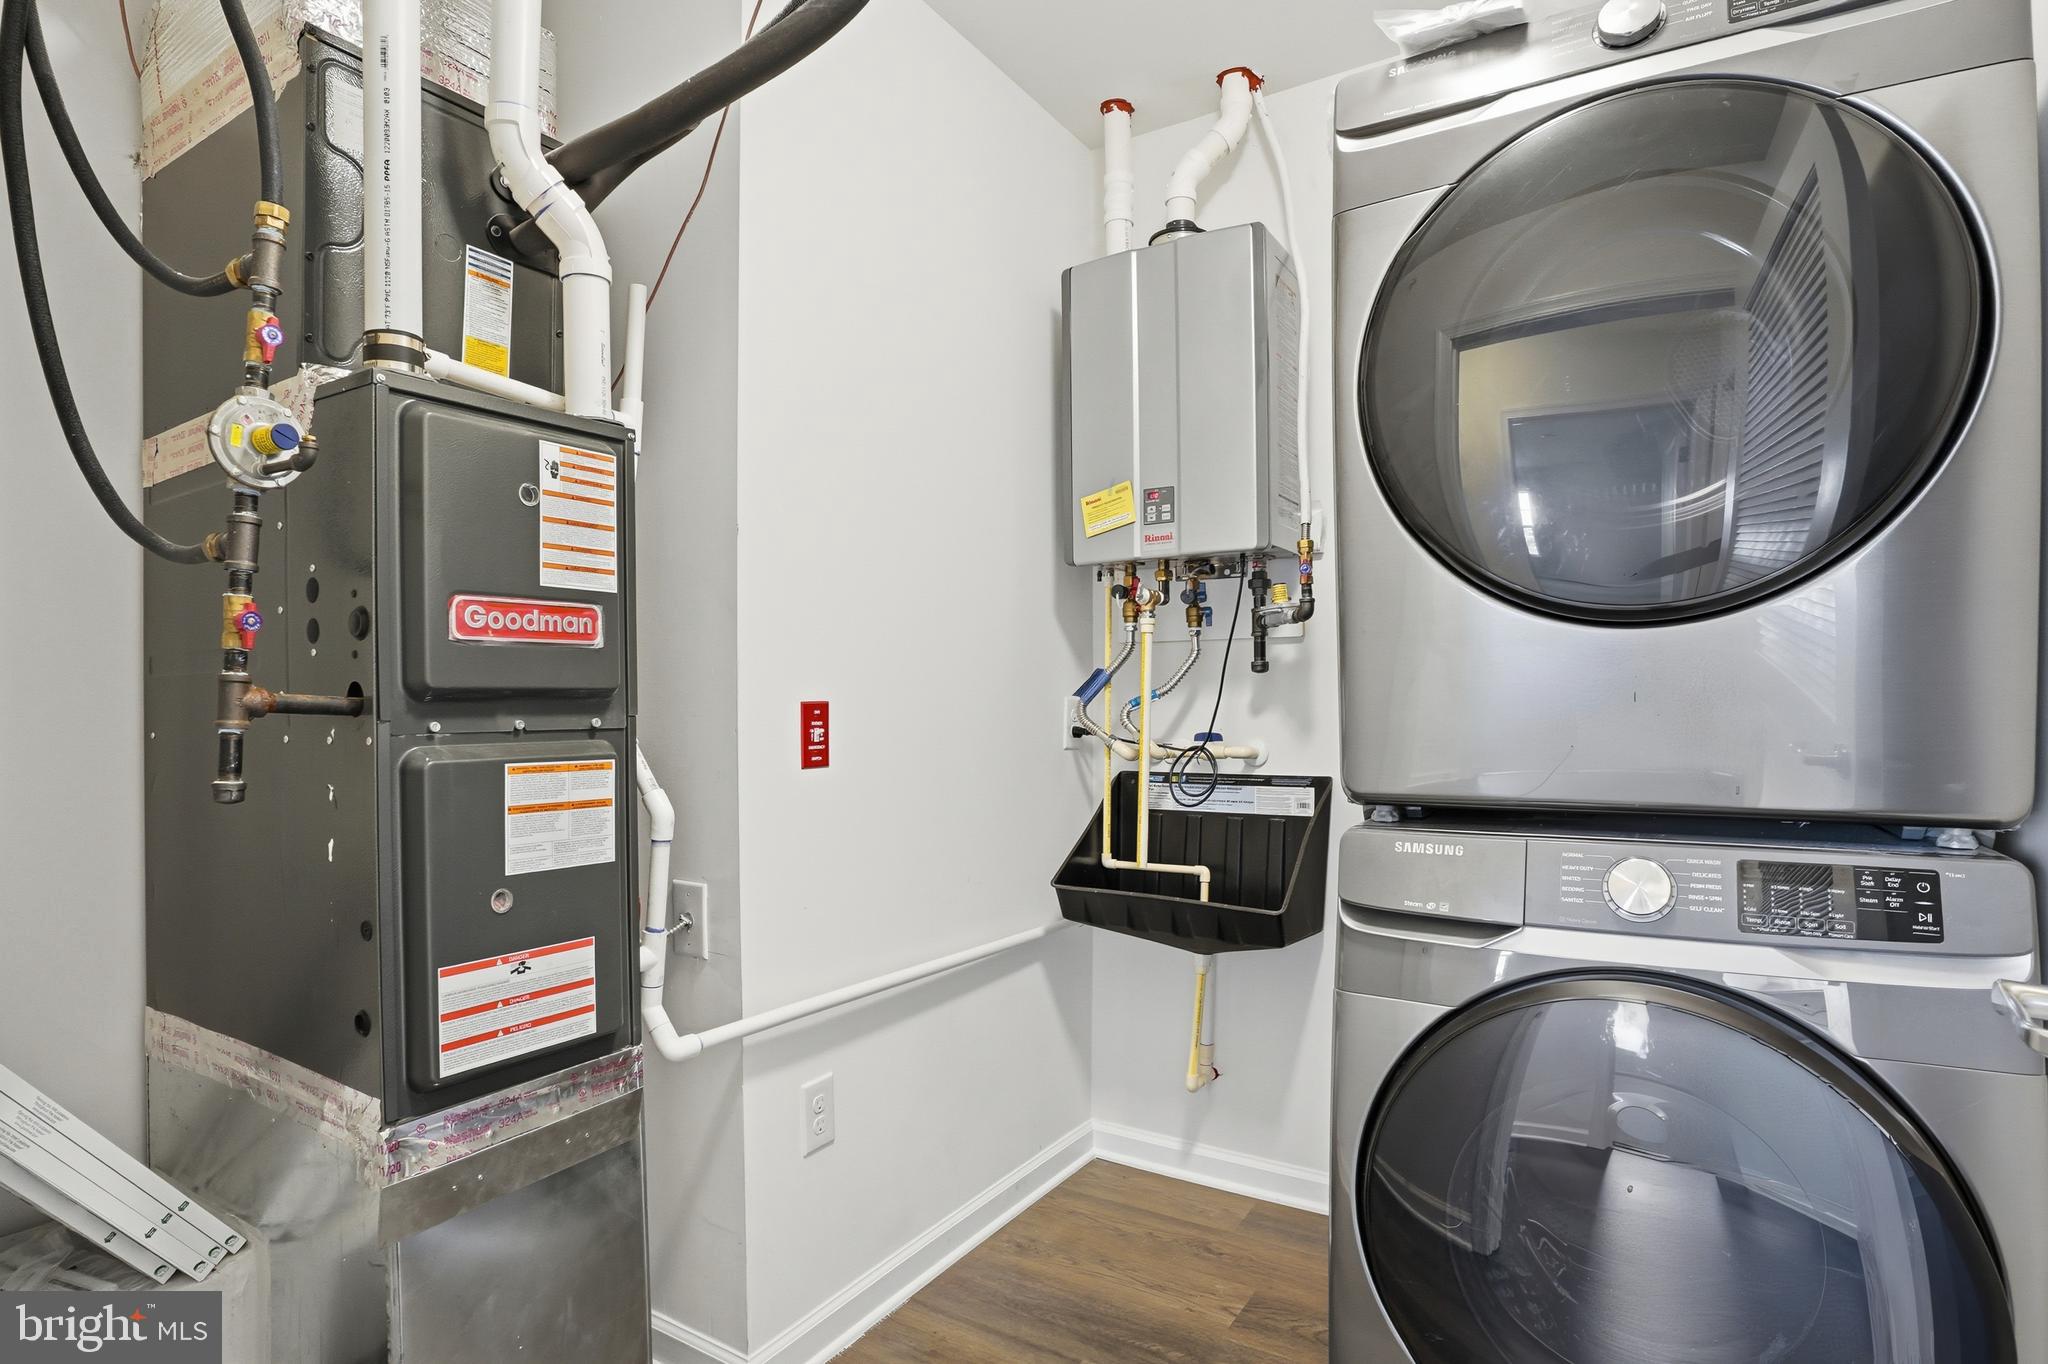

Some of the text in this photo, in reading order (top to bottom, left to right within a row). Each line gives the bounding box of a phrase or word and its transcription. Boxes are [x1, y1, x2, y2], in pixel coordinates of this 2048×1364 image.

[1144, 532, 1173, 542] Rinnai
[464, 605, 593, 634] Goodman
[1394, 841, 1464, 856] SAMSUNG
[509, 996, 530, 1004] DANGER
[499, 1112, 524, 1129] 324A
